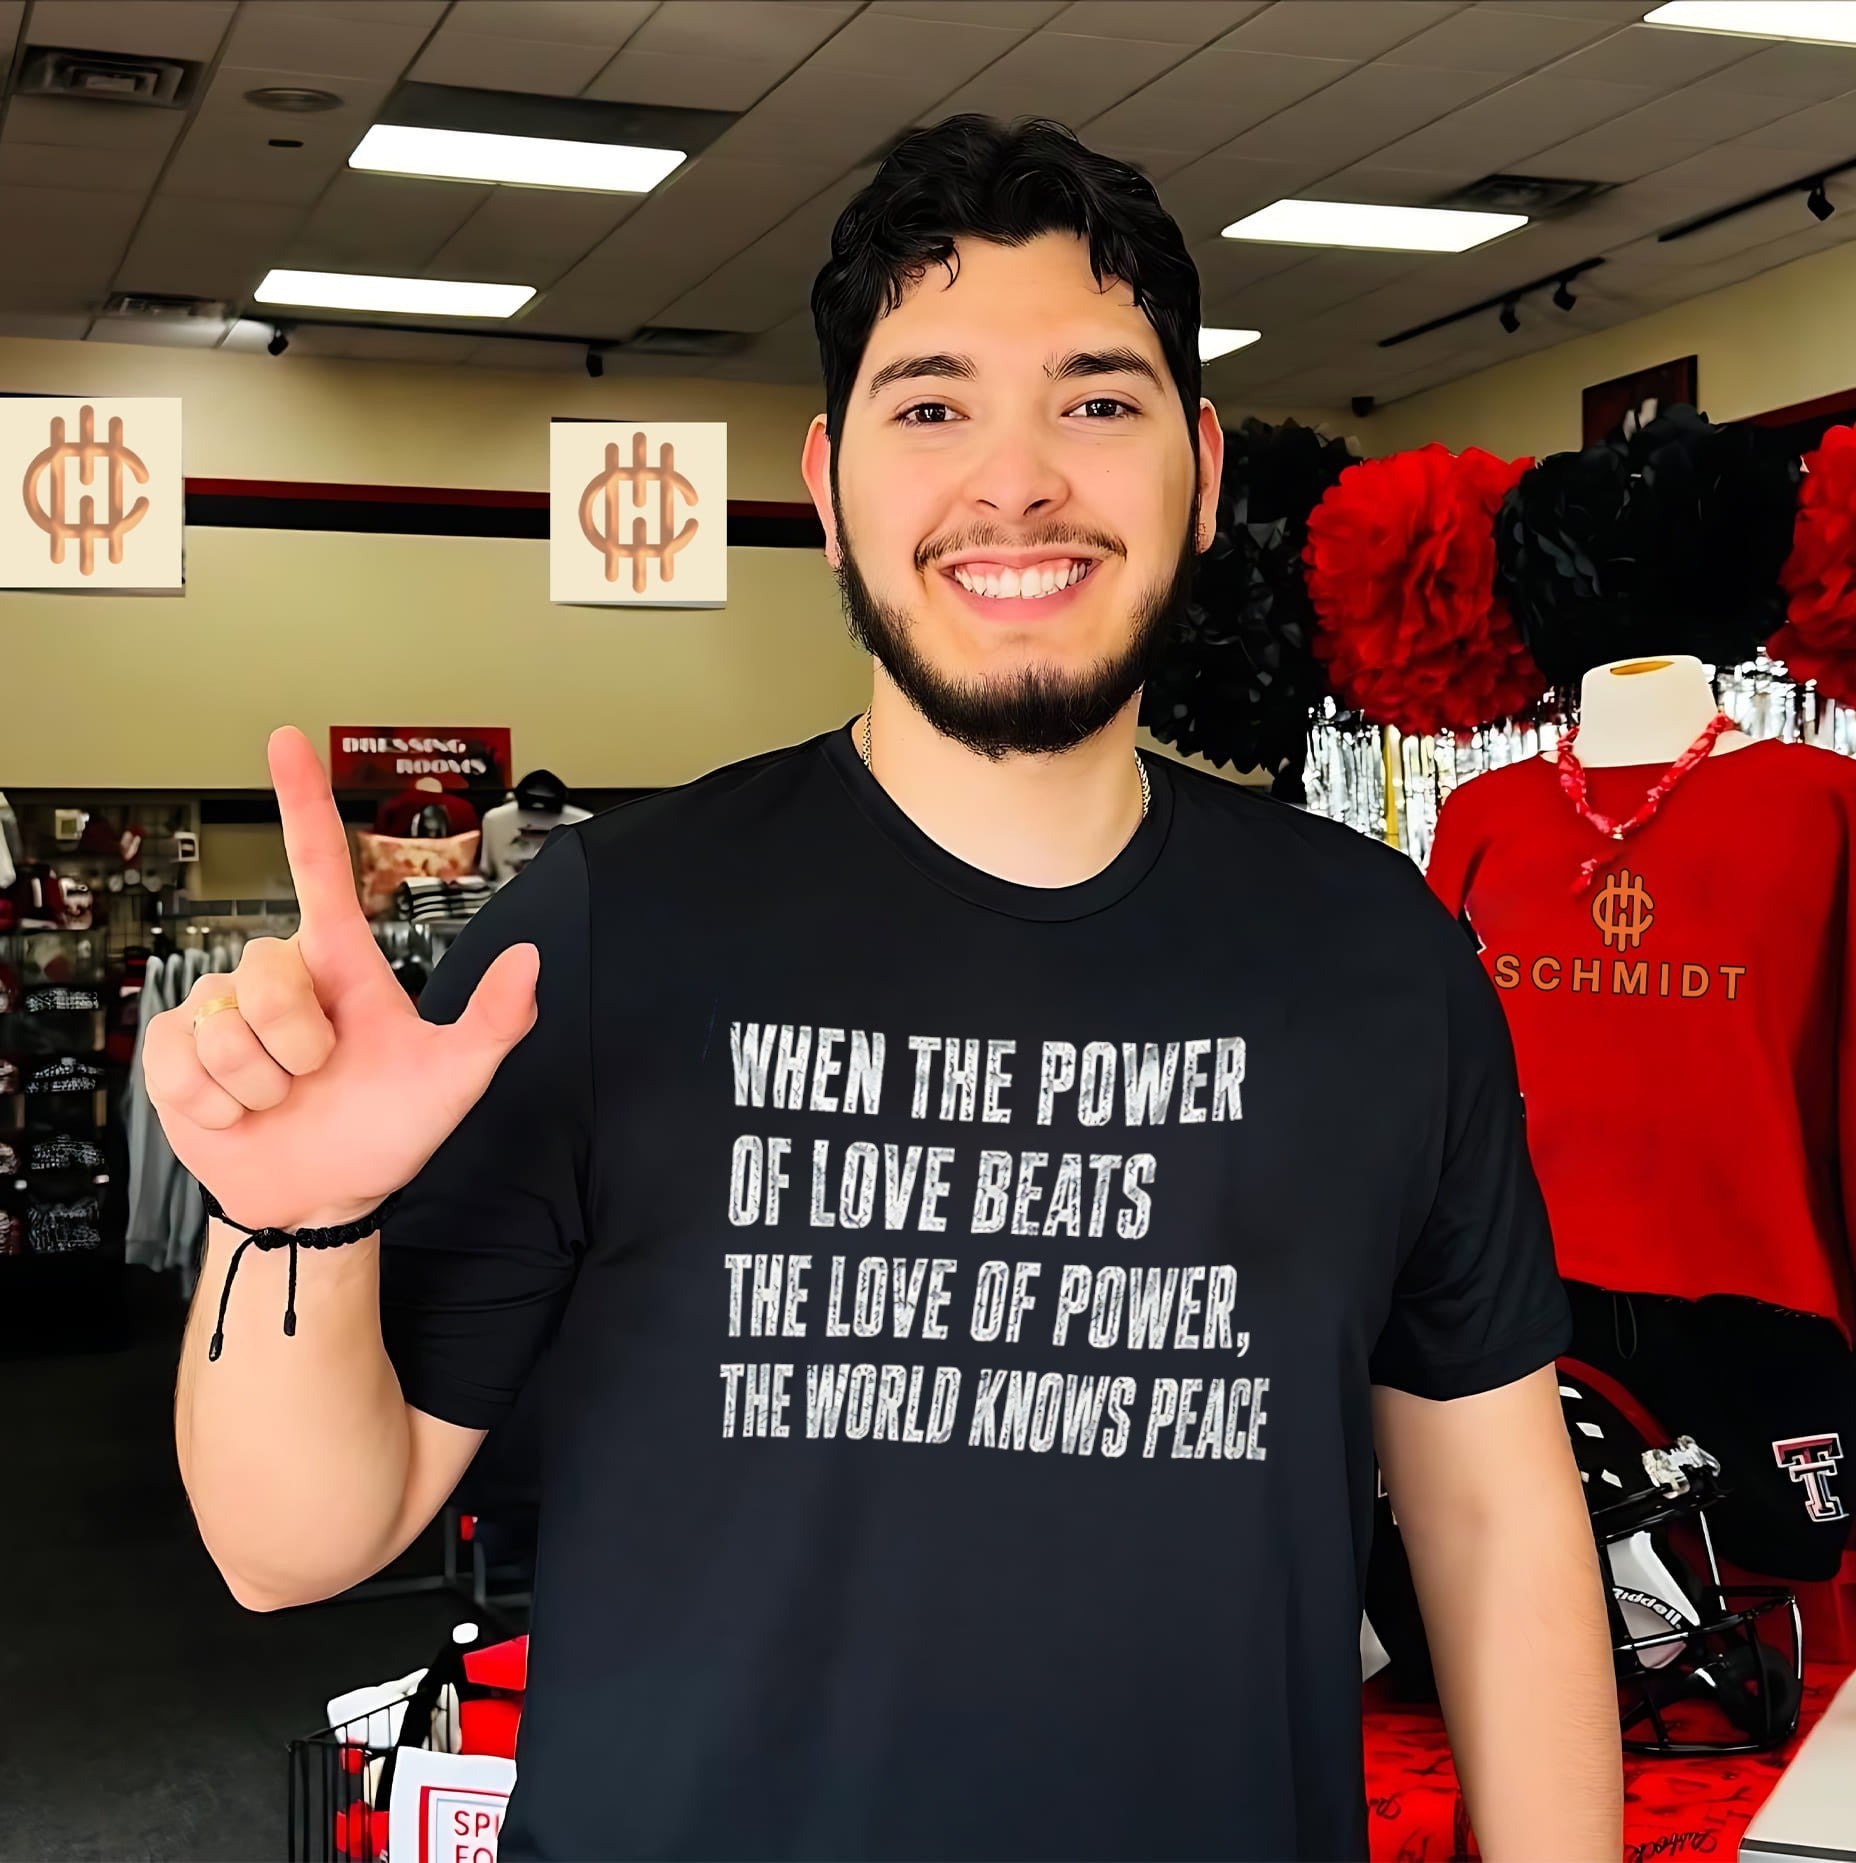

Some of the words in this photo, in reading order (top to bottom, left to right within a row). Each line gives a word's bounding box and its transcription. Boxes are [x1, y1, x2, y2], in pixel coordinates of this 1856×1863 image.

[1493, 952, 1747, 1001] SCHMIDT
[729, 1021, 886, 1116] WHEN
[907, 1035, 1017, 1125] THE
[1036, 1036, 1247, 1128] POWER
[727, 1134, 792, 1227] OF
[809, 1139, 956, 1233] LOVE
[970, 1149, 1158, 1241] BEATS
[723, 1253, 813, 1338] THE
[825, 1255, 958, 1341] LOVE
[969, 1260, 1042, 1344] OF
[1051, 1264, 1251, 1358] POWER,
[719, 1362, 795, 1439] THE
[805, 1362, 963, 1445] WORLD
[967, 1368, 1137, 1459] KNOWS
[1142, 1377, 1271, 1462] PEACE
